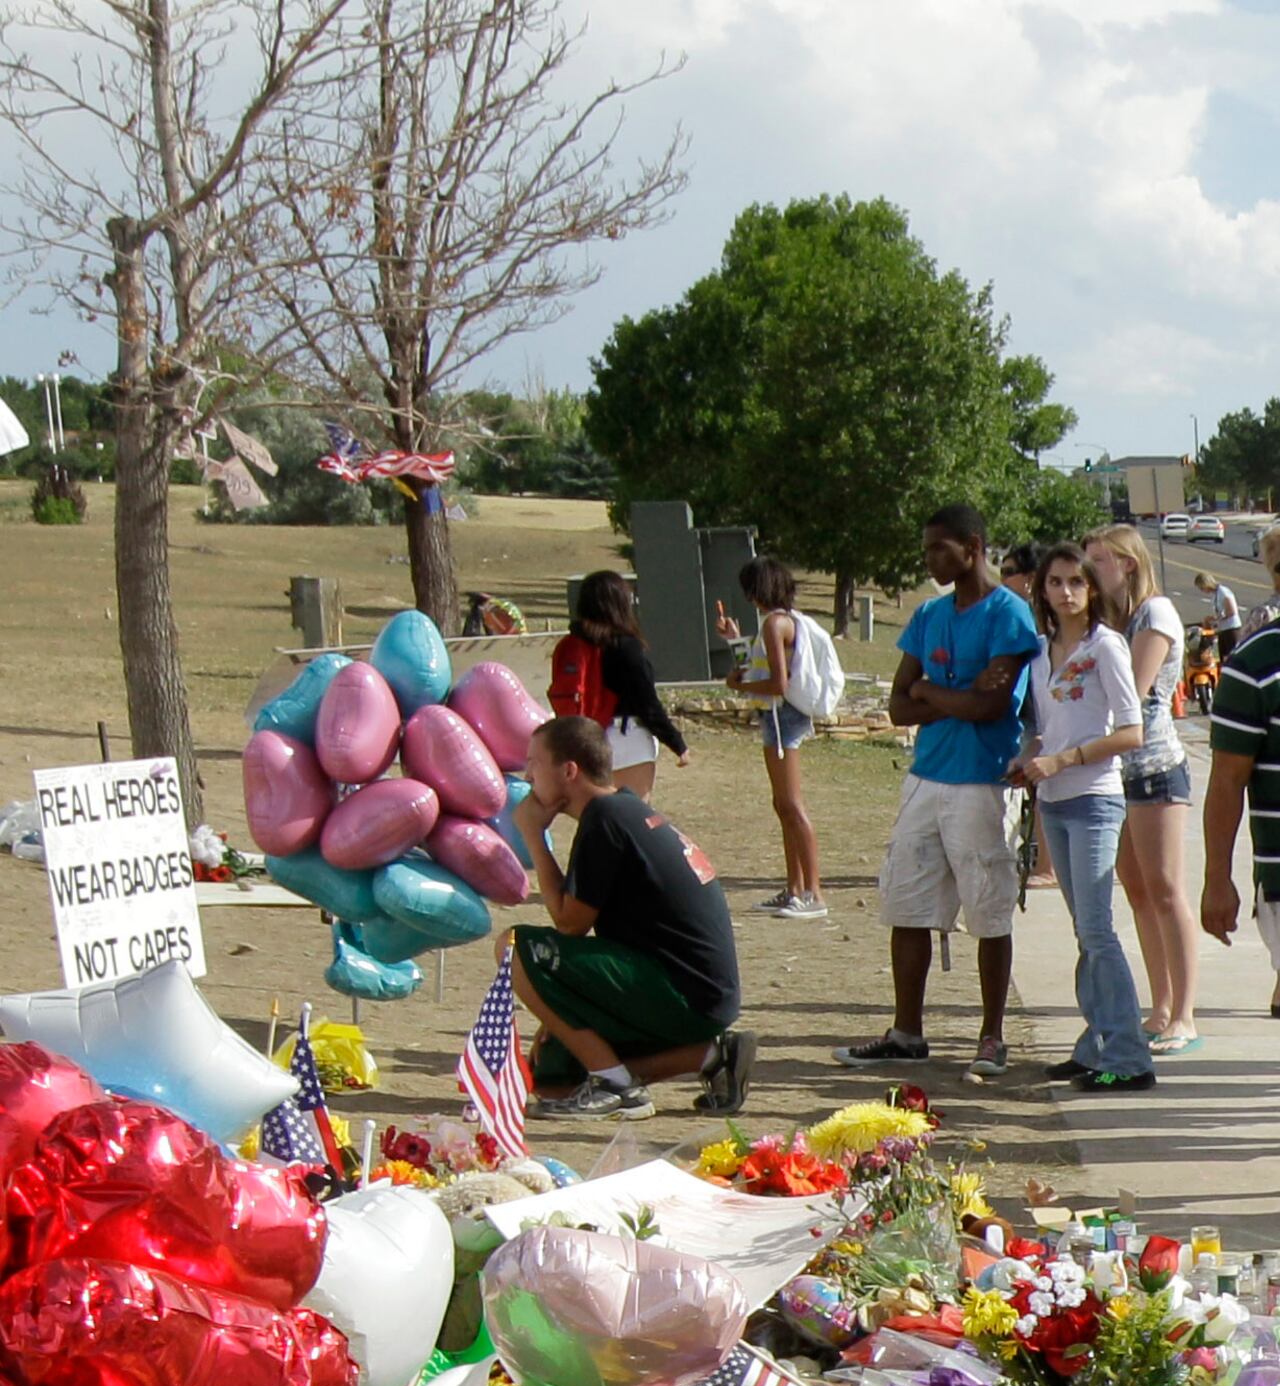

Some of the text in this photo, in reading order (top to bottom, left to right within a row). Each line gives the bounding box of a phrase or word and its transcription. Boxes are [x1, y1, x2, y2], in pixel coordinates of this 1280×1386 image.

[40, 775, 181, 828] REAL HEROES
[50, 851, 193, 908] WEAR BADGES
[74, 926, 192, 983] NOT CAPES
